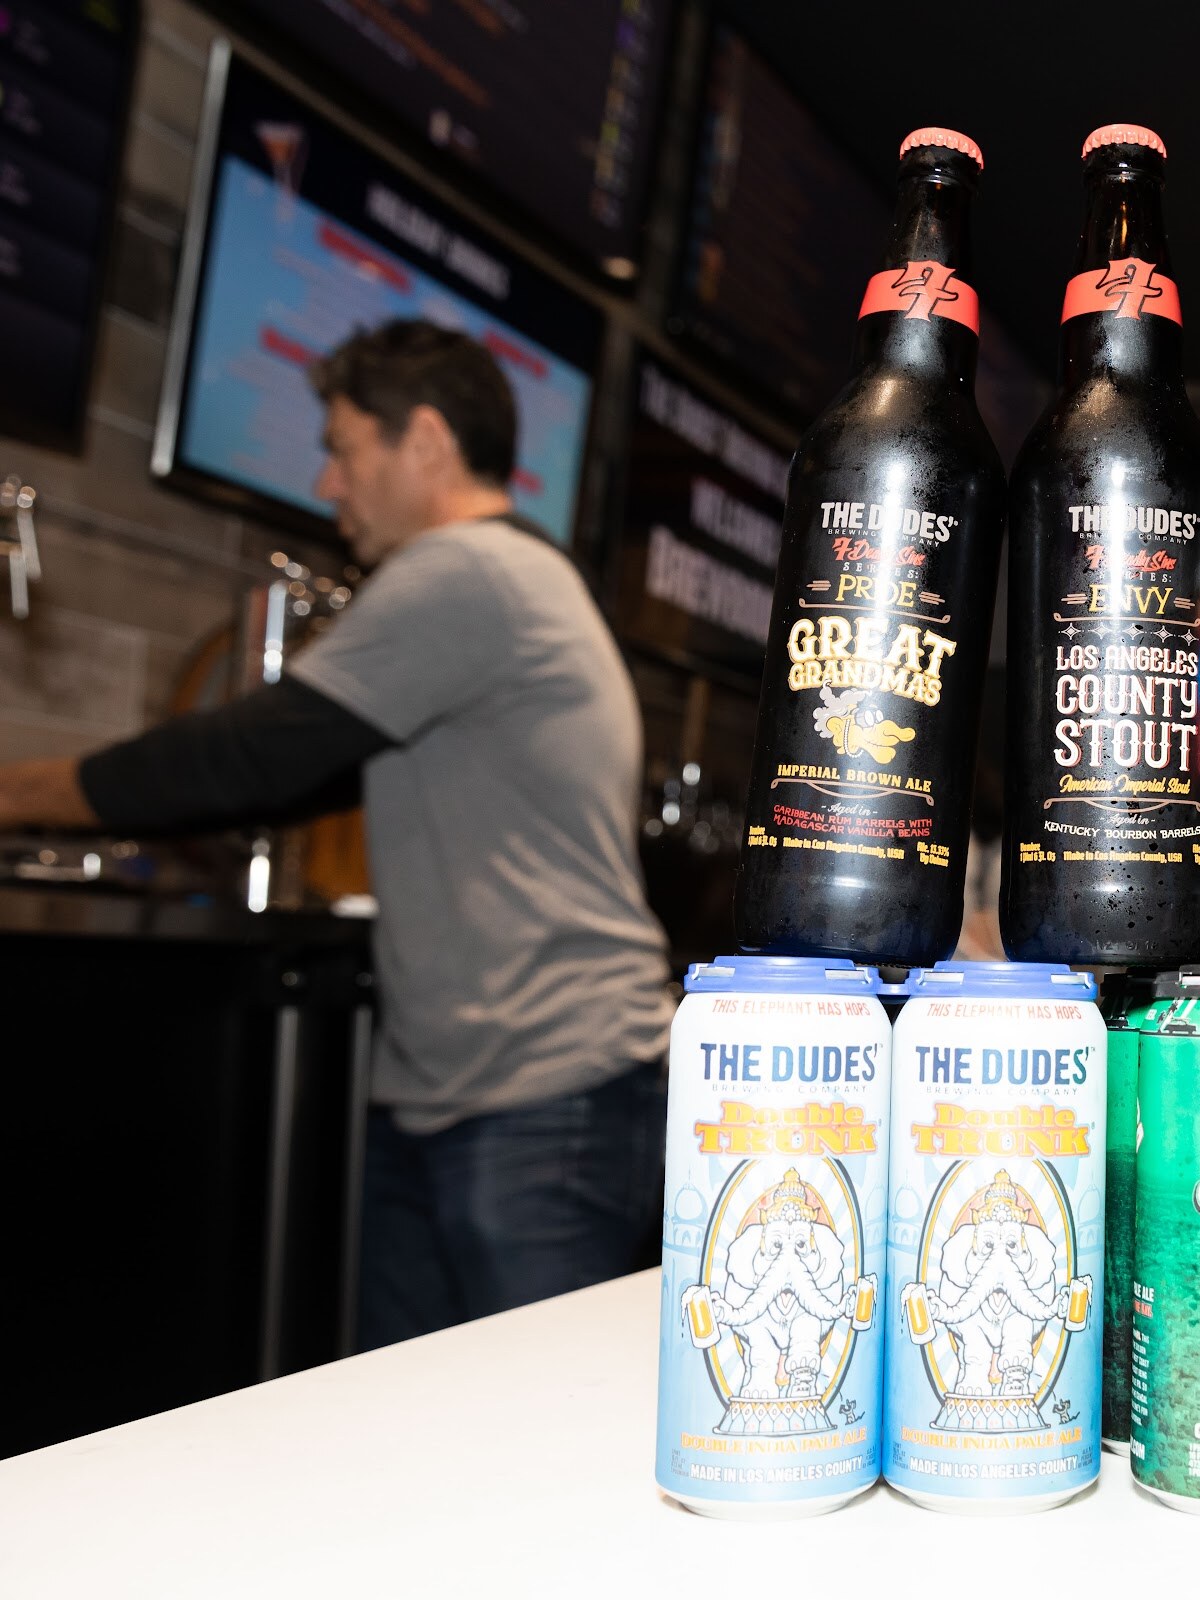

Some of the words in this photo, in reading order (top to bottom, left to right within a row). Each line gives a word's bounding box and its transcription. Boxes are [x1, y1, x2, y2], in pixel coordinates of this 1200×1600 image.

[821, 502, 865, 529] THE
[868, 504, 956, 542] DDES'
[828, 528, 877, 538] BREWING
[1118, 507, 1198, 540] DUDES'
[832, 537, 853, 561] 7
[1139, 533, 1188, 546] COMPANY
[1085, 544, 1105, 569] 7
[1150, 549, 1178, 572] Sins
[1088, 584, 1174, 615] ENVY
[787, 615, 957, 679] GREAT
[1056, 645, 1101, 671] LOS
[1104, 645, 1199, 677] ANGELES
[1055, 674, 1199, 720] COUNTY
[1053, 718, 1199, 772] STOUT
[778, 764, 840, 781] IMPERIAL
[847, 769, 902, 788] BROWN
[905, 777, 933, 793] ALE
[1059, 774, 1113, 794] American
[1114, 774, 1166, 796] Imperial
[1168, 776, 1191, 795] Stout
[773, 804, 824, 824] CARIBBEAN
[828, 814, 852, 826] RUM
[856, 817, 906, 829] BARRELS
[909, 818, 933, 829] WITH
[828, 802, 857, 817] Aged
[858, 803, 872, 817] in
[1108, 813, 1137, 828] Aged
[773, 813, 845, 835] MADAGASCAR
[848, 825, 895, 838] VANILLA
[898, 828, 931, 838] BEANS
[1044, 820, 1100, 838] KENTUCKY
[1104, 829, 1157, 840] BOURBON
[783, 836, 803, 848] Made
[811, 838, 826, 850] Los
[826, 840, 857, 853] Angeles
[858, 843, 886, 859] County,
[887, 847, 904, 860] USA
[1063, 850, 1085, 861] Made
[1085, 850, 1094, 860] in
[1094, 851, 1109, 861] Los
[1109, 850, 1140, 863] Angeles
[1141, 852, 1167, 863] County,
[1168, 853, 1182, 862] USA
[712, 999, 738, 1014] THIS
[742, 1000, 812, 1016] ELEPHANT
[818, 1001, 842, 1016] HAS
[844, 1002, 871, 1016] HOPS
[927, 1003, 951, 1017] THIS
[955, 1003, 1021, 1019] ELEPHANT
[1027, 1005, 1052, 1020] HAS
[1054, 1005, 1082, 1020] HOPS
[700, 1042, 762, 1081] THE
[771, 1043, 878, 1083] DUDES'
[916, 1045, 972, 1084] THE
[982, 1046, 1089, 1086] DUDES'
[798, 1083, 868, 1094] COMPANY
[1008, 1087, 1078, 1096] COMPANY
[720, 1100, 865, 1126] Double
[934, 1102, 1077, 1128] Double
[694, 1121, 878, 1156] TRUNK
[911, 1122, 1092, 1158] TRUNK
[1142, 1286, 1154, 1303] ALE
[681, 1432, 745, 1456] DOUBLE
[747, 1438, 798, 1455] INDIA
[800, 1434, 841, 1453] PALE
[844, 1426, 867, 1444] ALE
[902, 1426, 959, 1450] DOUBLE
[962, 1434, 1012, 1450] INDIA
[1015, 1431, 1056, 1450] PALE
[1057, 1427, 1082, 1445] ALE
[690, 1463, 722, 1482] MADE
[724, 1466, 737, 1482] IN
[739, 1465, 765, 1484] LOS
[767, 1463, 824, 1484] ANGELES
[826, 1455, 863, 1477] COUNTY
[910, 1456, 938, 1476] MADE
[940, 1460, 952, 1477] IN
[954, 1462, 979, 1479] LOS
[980, 1461, 1037, 1480] ANGELES
[1038, 1455, 1078, 1477] COUNTY
